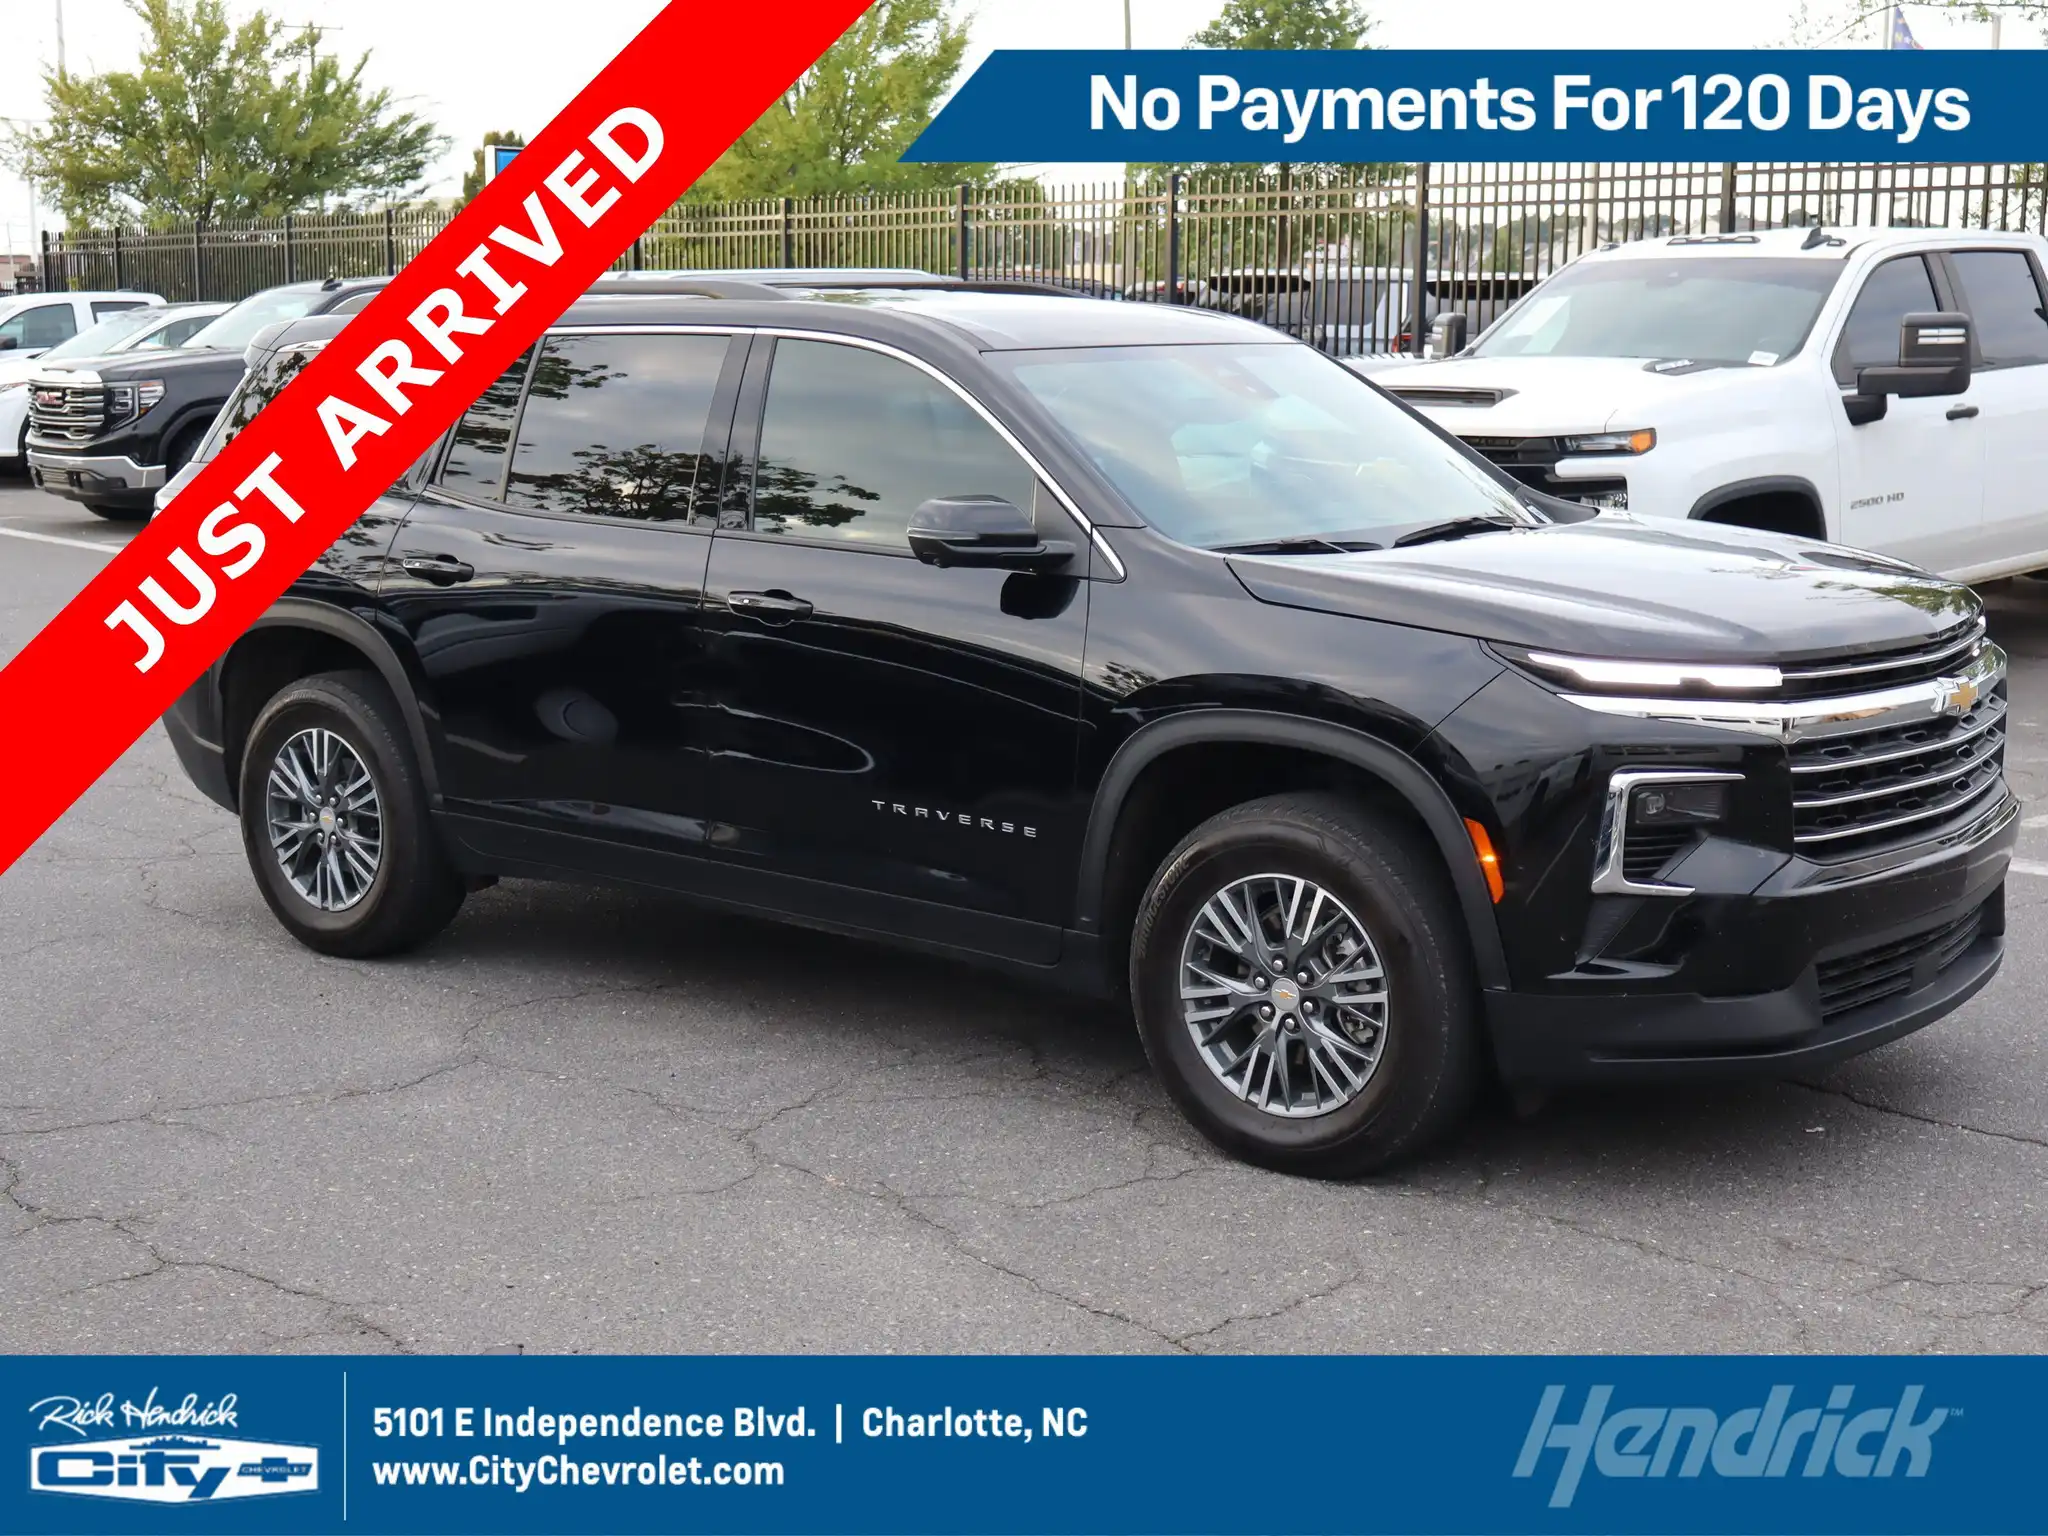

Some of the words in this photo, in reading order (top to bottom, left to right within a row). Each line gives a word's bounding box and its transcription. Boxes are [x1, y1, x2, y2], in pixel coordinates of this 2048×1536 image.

[1850, 495, 1884, 510] 2500
[1886, 492, 1905, 503] HD
[871, 799, 1037, 838] TRAVERSE
